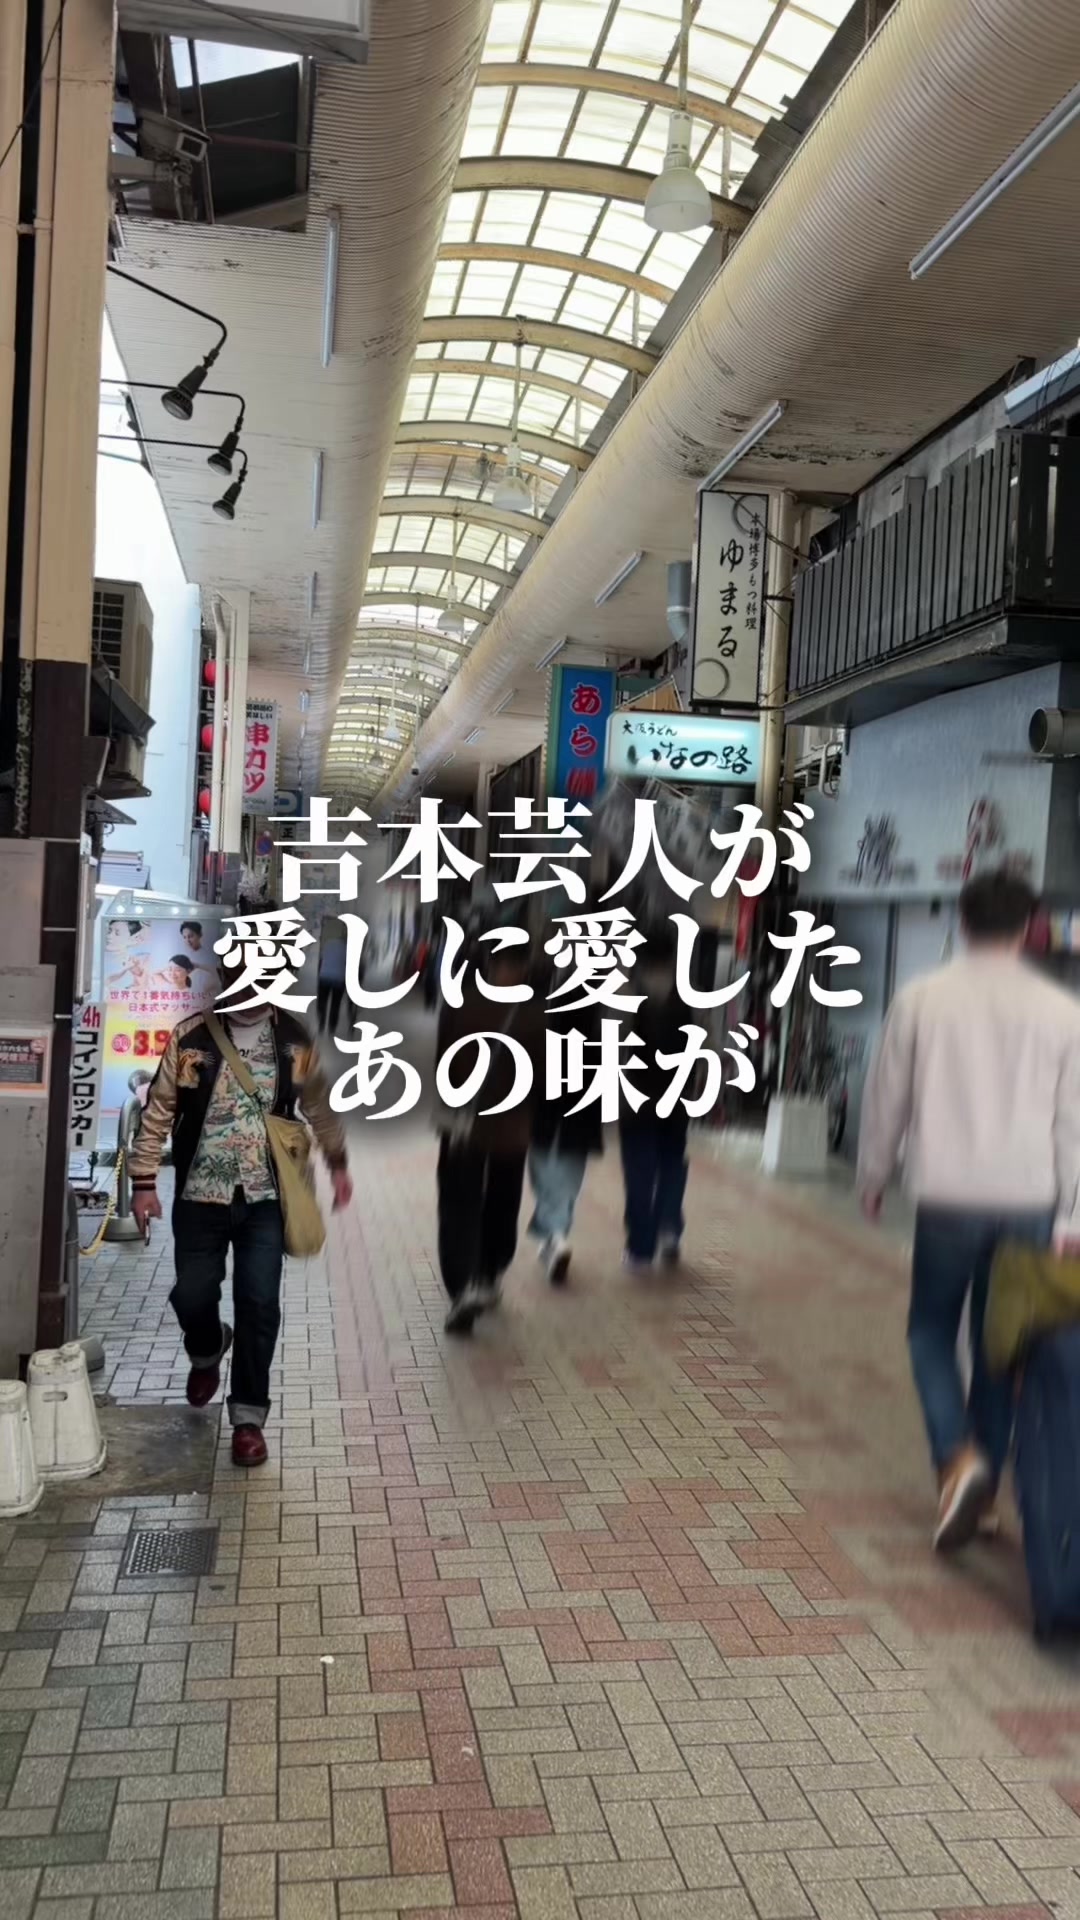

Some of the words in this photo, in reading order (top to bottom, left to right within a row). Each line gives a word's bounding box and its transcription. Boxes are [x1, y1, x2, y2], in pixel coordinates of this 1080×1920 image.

[717, 538, 745, 660] ゆまる
[244, 721, 271, 794] 串カツ
[70, 1031, 99, 1147] コインロッカー
